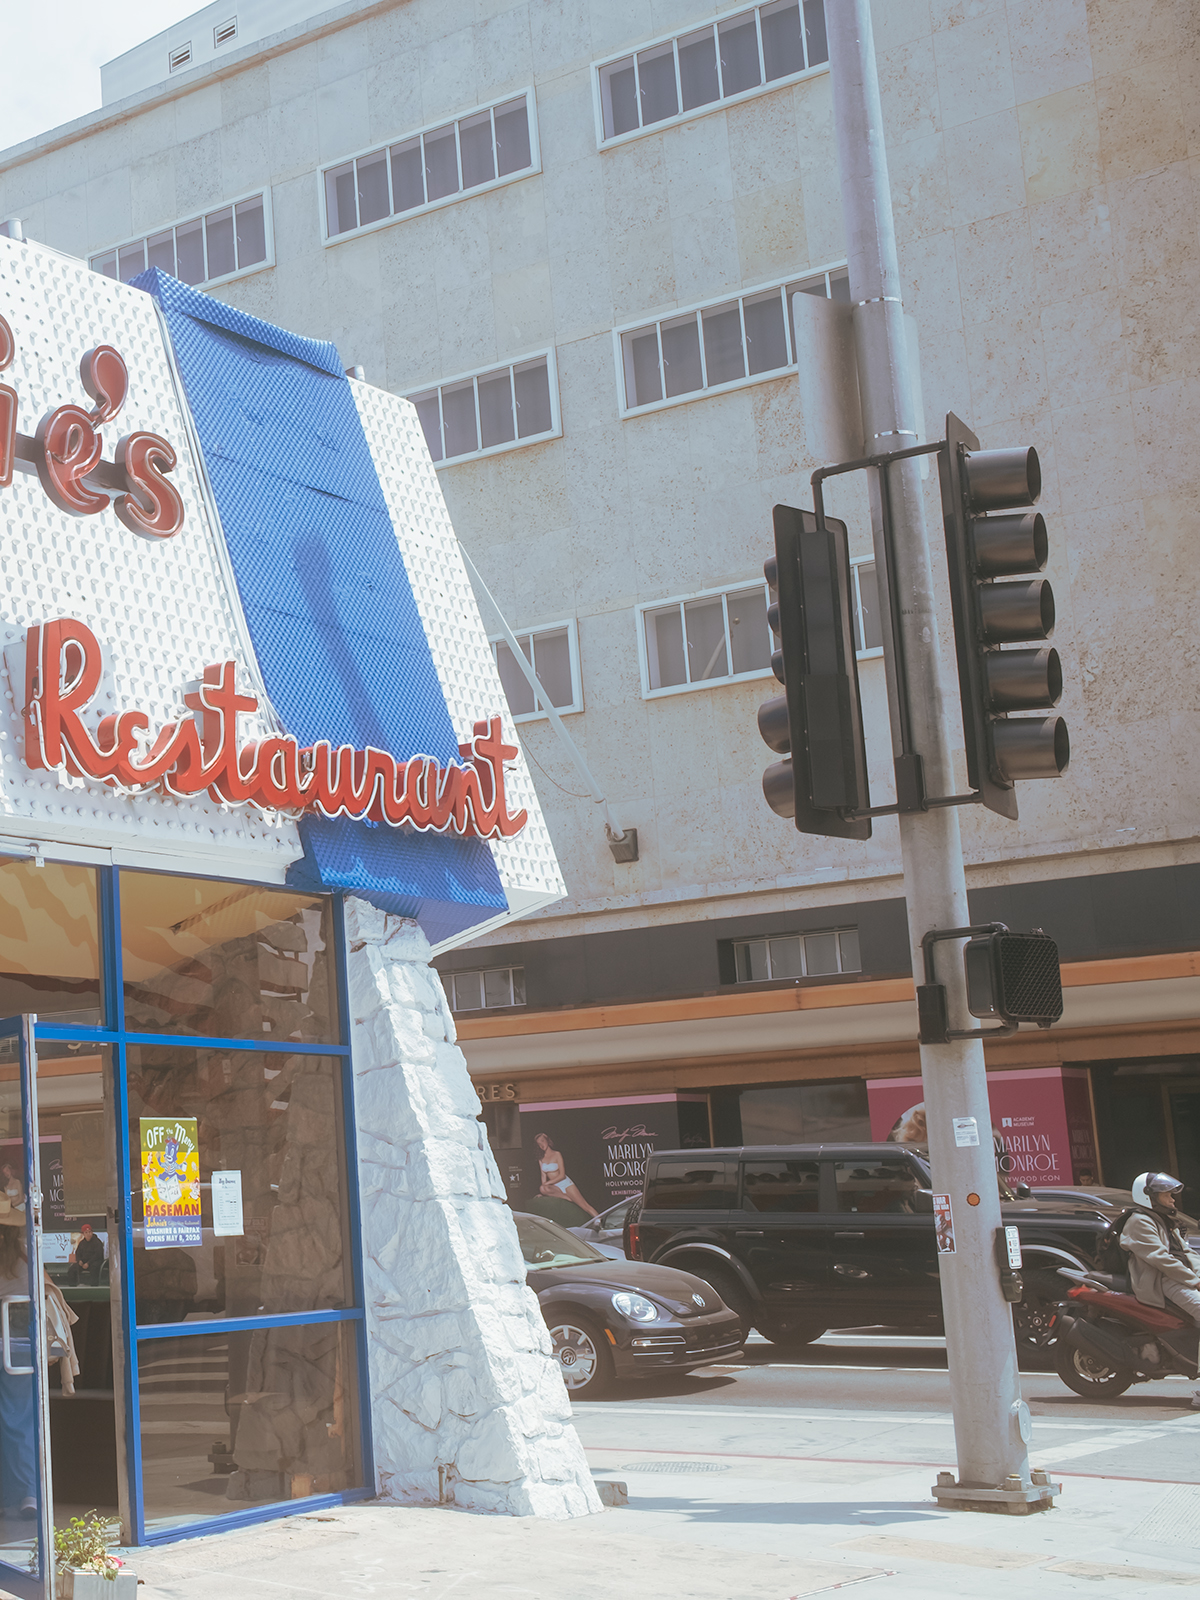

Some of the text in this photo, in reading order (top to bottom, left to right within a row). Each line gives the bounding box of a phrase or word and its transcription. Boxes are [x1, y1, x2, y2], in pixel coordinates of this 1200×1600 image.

[24, 616, 528, 843] Restaurant
[146, 1126, 165, 1149] OFF
[993, 1134, 1051, 1153] MARILYN
[607, 1143, 654, 1160] MARILYN
[605, 1179, 644, 1188] HOLLYWOOD
[1040, 1174, 1061, 1182] ICON
[145, 1204, 200, 1217] BASEMAN
[146, 1227, 172, 1235] WILSHIRE
[178, 1226, 200, 1234] FAIRFAX
[146, 1235, 165, 1243] OPENS
[166, 1234, 178, 1242] MAY
